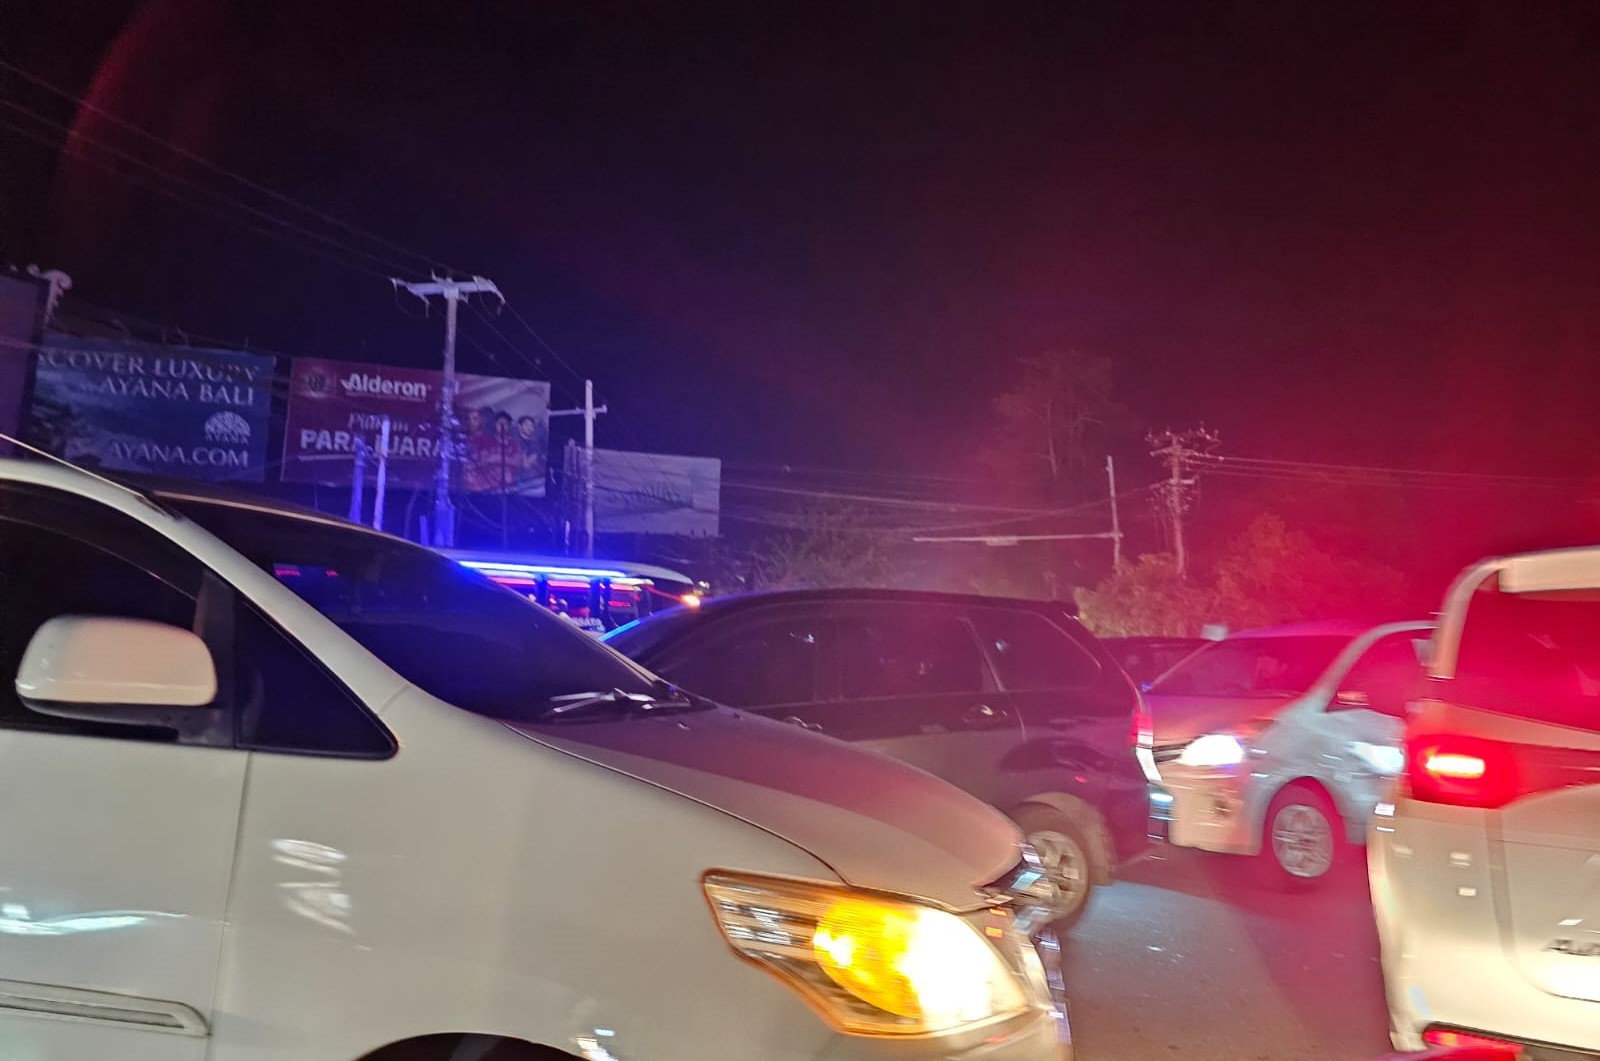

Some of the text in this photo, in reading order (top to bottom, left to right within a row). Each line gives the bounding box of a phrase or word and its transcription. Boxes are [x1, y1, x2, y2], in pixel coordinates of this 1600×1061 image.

[101, 375, 254, 406] AYANA BALI
[340, 373, 427, 398] Alderon
[111, 441, 249, 467] AYANA.COM
